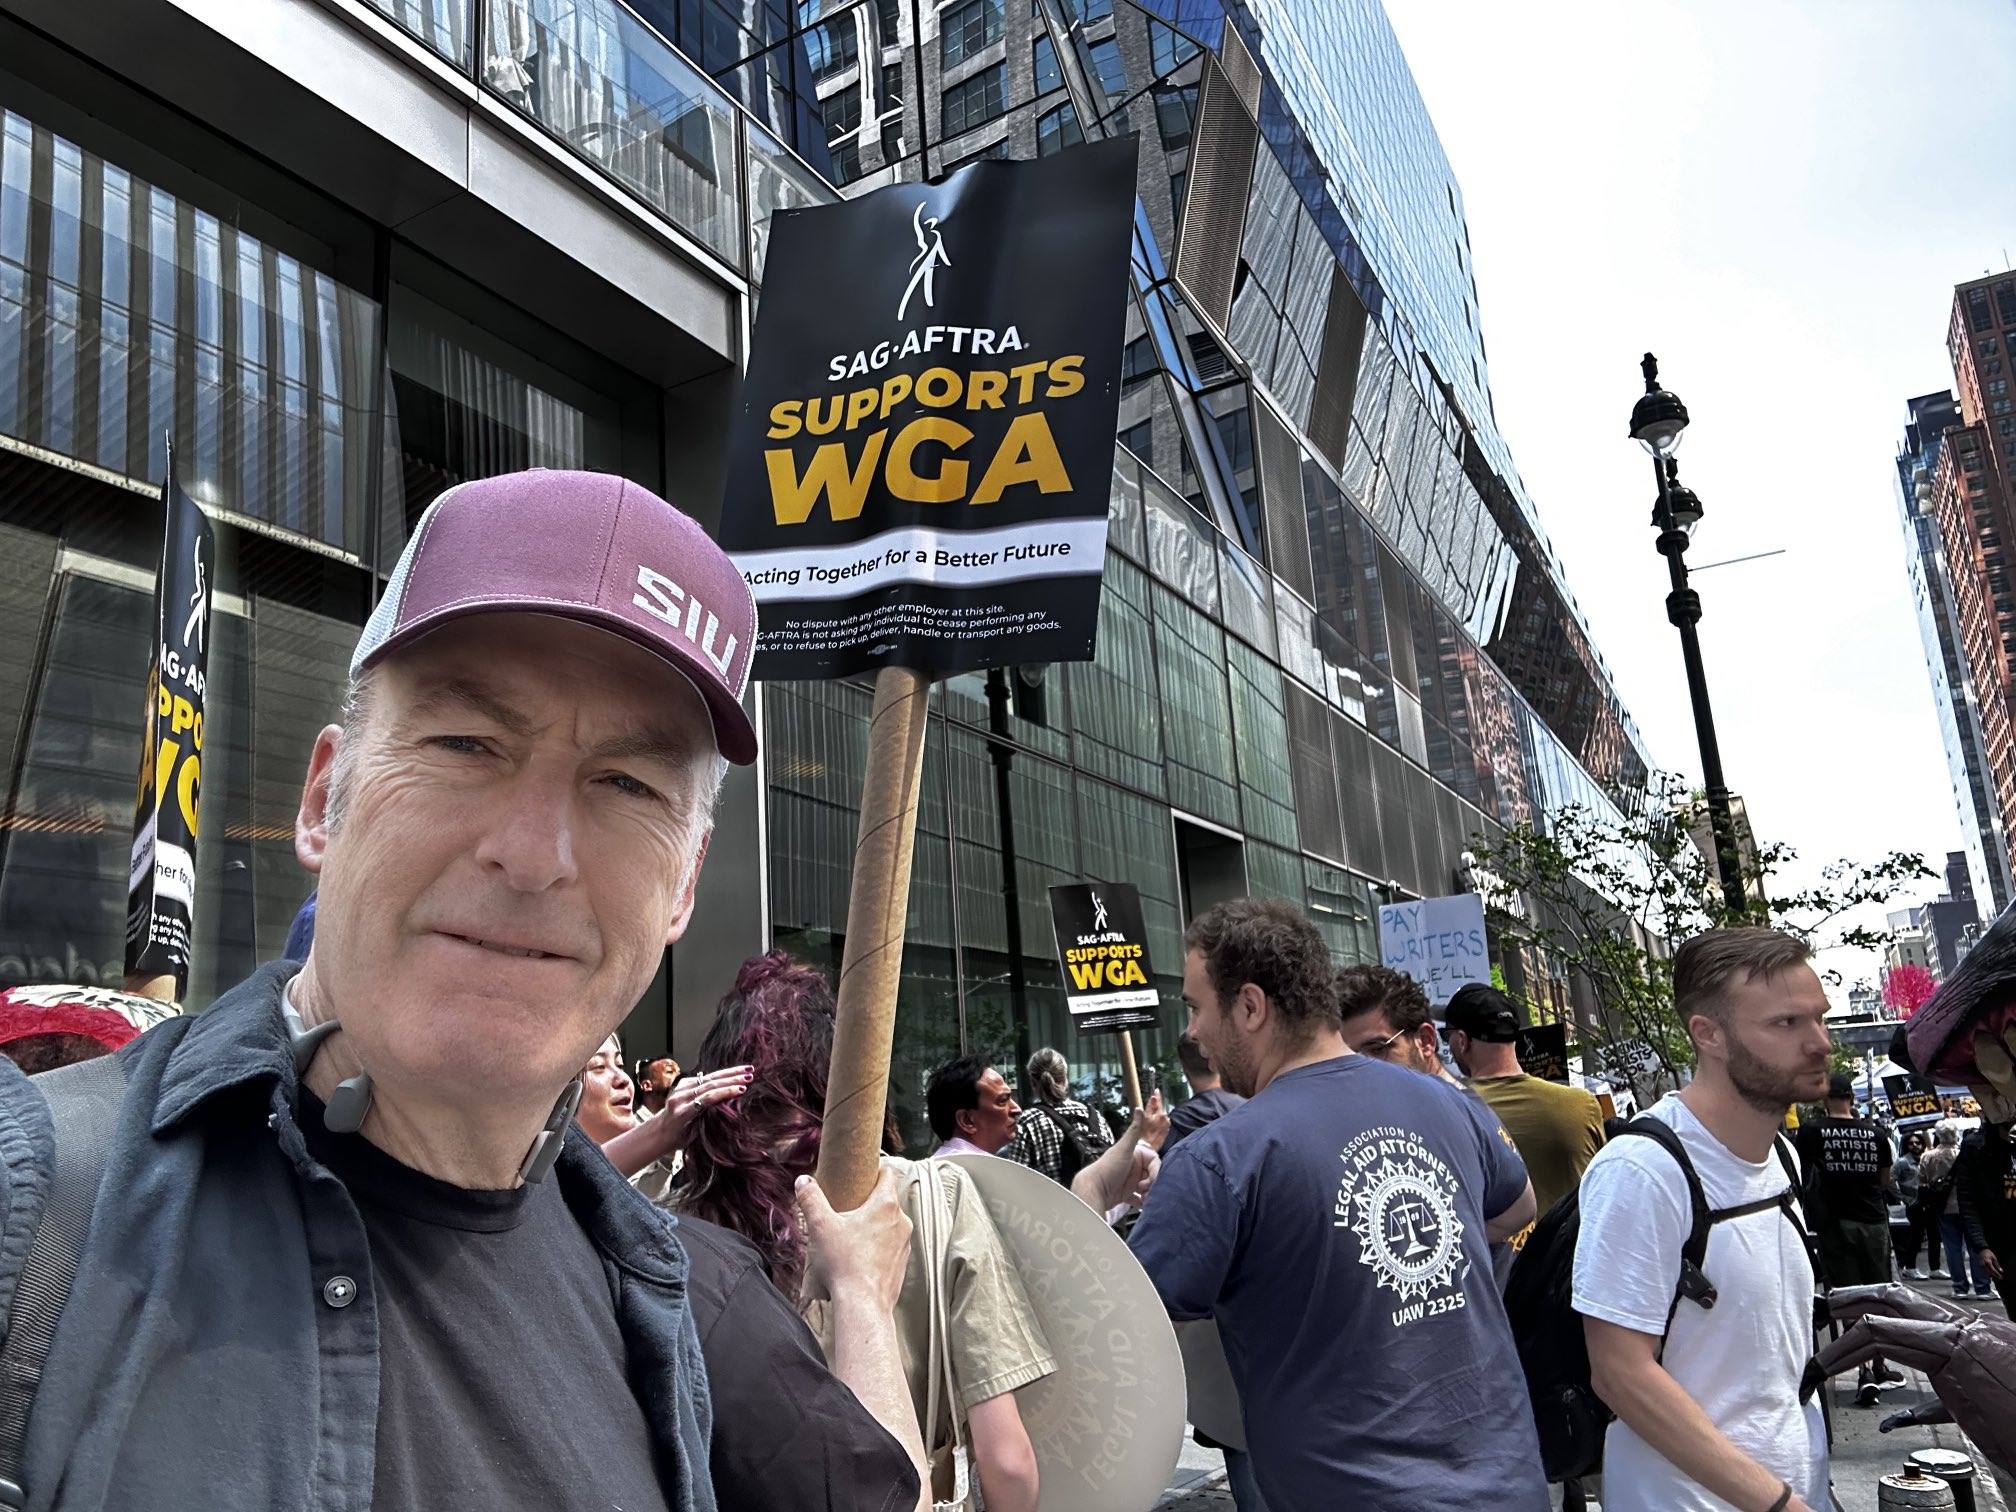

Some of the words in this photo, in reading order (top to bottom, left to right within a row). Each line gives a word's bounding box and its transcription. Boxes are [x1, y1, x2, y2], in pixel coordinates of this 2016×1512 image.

[766, 355, 1085, 439] SUPPORTS
[764, 411, 1074, 526] WGA
[743, 567, 800, 586] Acting
[806, 557, 882, 584] Together
[885, 548, 911, 566] for
[915, 550, 928, 563] a
[934, 549, 999, 568] Better
[1003, 543, 1071, 563] Future
[632, 564, 738, 677] SIU
[785, 620, 800, 629] No
[802, 619, 838, 631] dispute
[839, 615, 858, 626] with
[859, 612, 873, 622] any
[873, 605, 897, 617] other
[898, 603, 949, 617] employer
[951, 608, 963, 617] at
[965, 607, 984, 616] this
[986, 604, 1006, 614] site.
[802, 631, 810, 639] is
[812, 631, 829, 639] not
[830, 627, 858, 638] asking
[859, 622, 873, 632] any
[874, 613, 921, 627] individual
[923, 616, 934, 626] to
[936, 619, 967, 628] cease
[969, 612, 1025, 629] performing
[1027, 610, 1047, 620] any
[756, 643, 768, 652] es,
[770, 642, 781, 651] or
[783, 642, 794, 651] to
[795, 641, 826, 651] refuse
[827, 641, 838, 649] to
[839, 637, 856, 649] pick
[857, 633, 869, 644] up,
[870, 626, 901, 639] deliver,
[903, 625, 941, 638] handle
[943, 631, 955, 639] or
[957, 628, 1004, 639] transport
[1006, 624, 1025, 635] any
[1026, 620, 1062, 633] goods.
[1382, 905, 1421, 933] PAY
[1065, 944, 1143, 963] SUPPORTS
[1384, 929, 1485, 964] WRITERS
[1068, 959, 1148, 991] WGA
[1892, 1094, 1935, 1106] SUPPORTS
[1895, 1101, 1938, 1117] WGA
[1339, 1126, 1405, 1164] ASSOCIATION
[1409, 1132, 1424, 1144] OF
[1820, 1127, 1875, 1139] MAKEUP
[1823, 1139, 1878, 1151] ARTISTS
[1825, 1151, 1834, 1160] &
[1841, 1150, 1878, 1162] HAIR
[1826, 1162, 1878, 1173] STYLISTS
[1333, 1168, 1360, 1228] LEGAL
[1353, 1143, 1378, 1172] AID
[1378, 1139, 1460, 1193] ATTORNEYS
[1391, 1301, 1425, 1328] UAW
[1427, 1291, 1466, 1317] 2325
